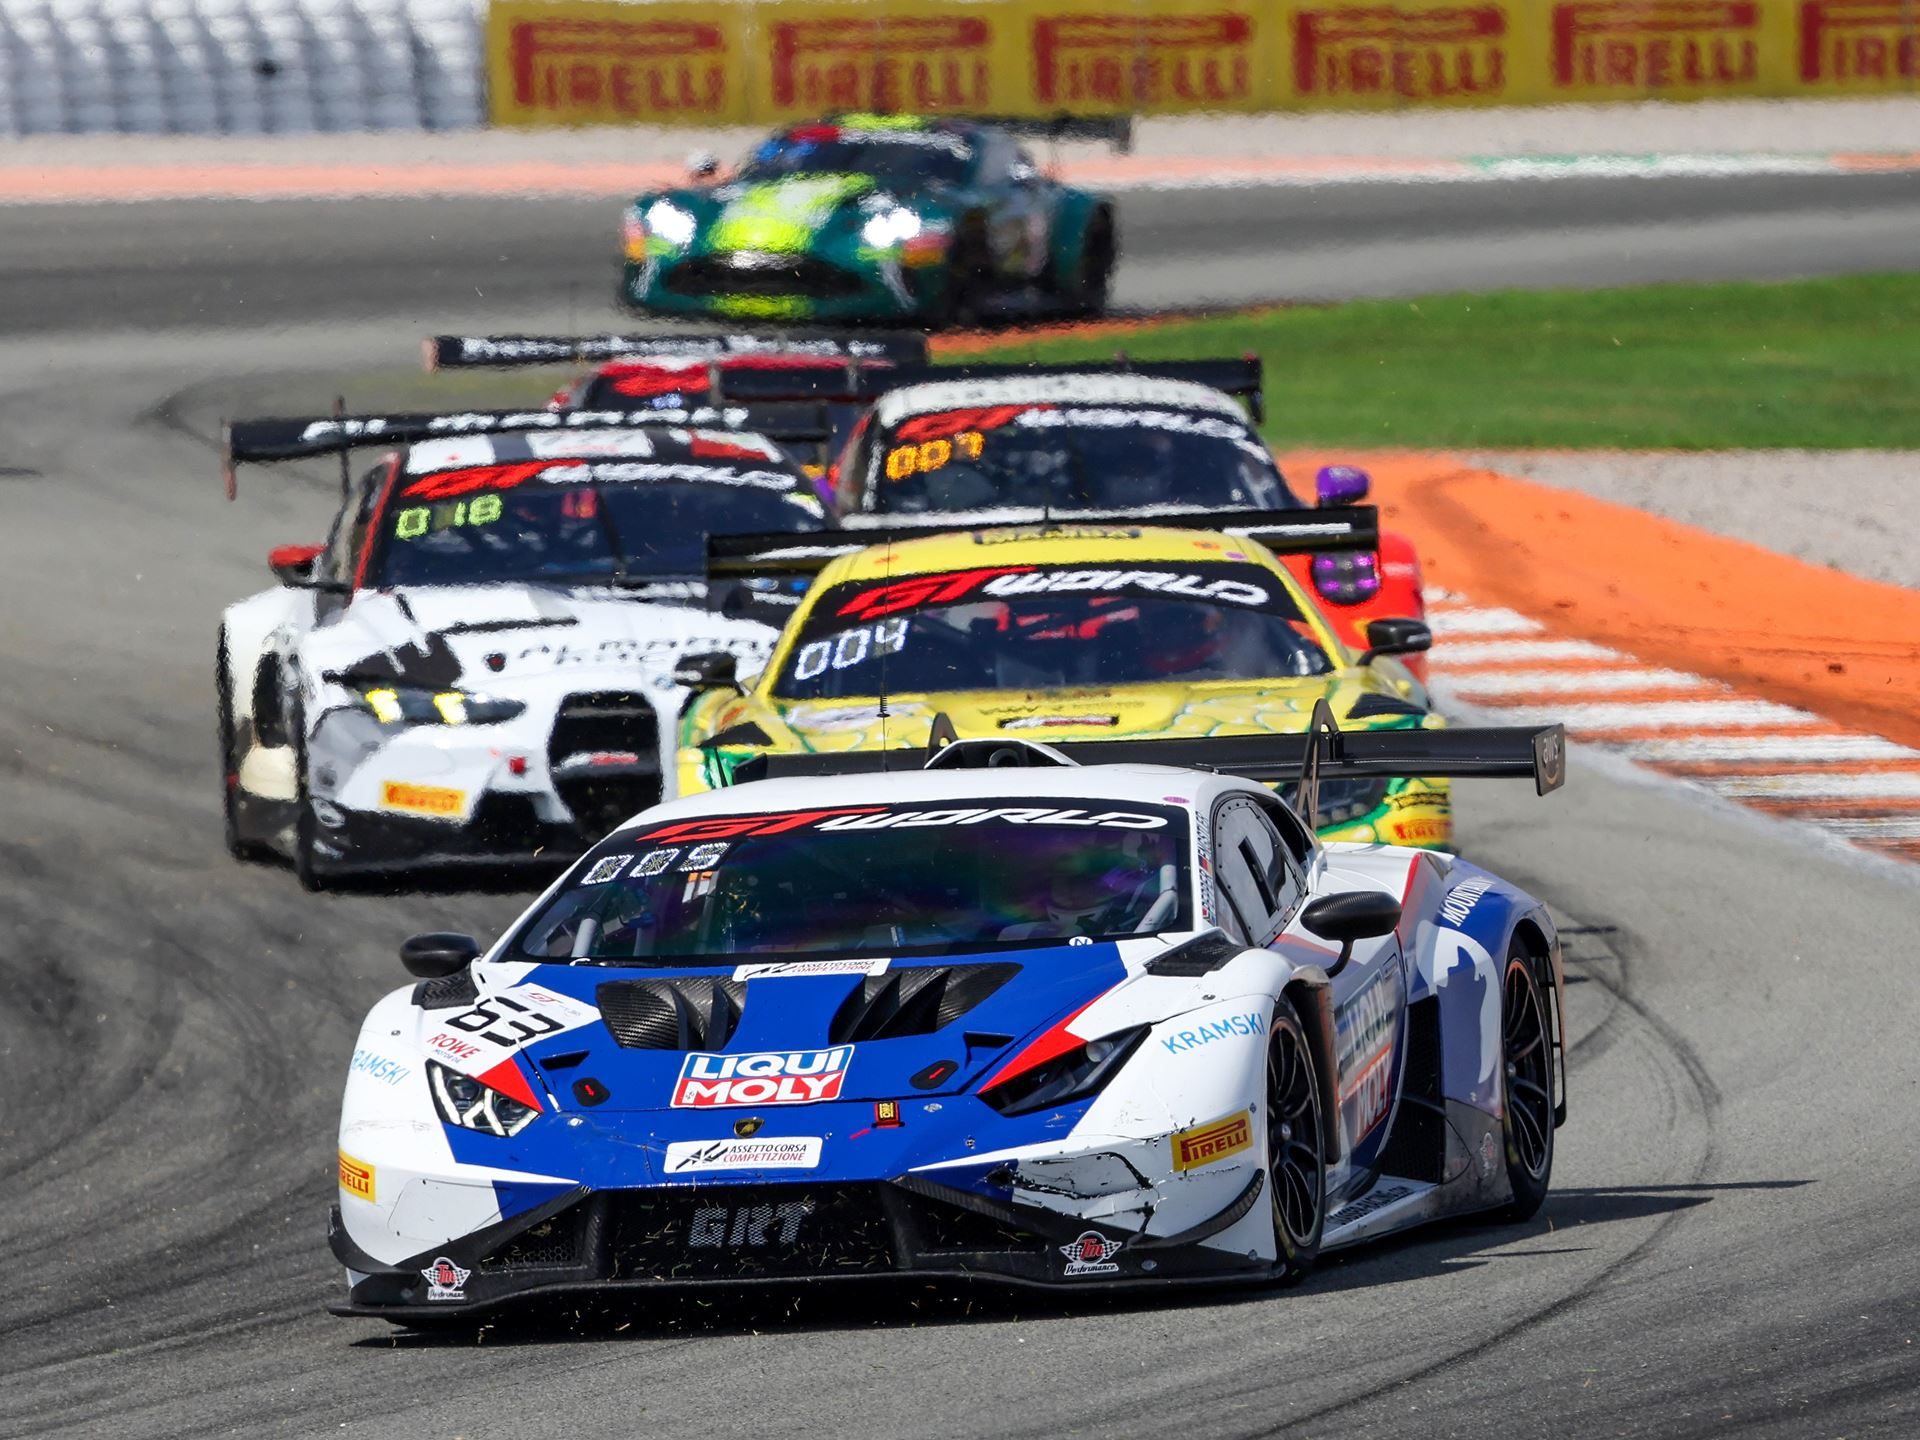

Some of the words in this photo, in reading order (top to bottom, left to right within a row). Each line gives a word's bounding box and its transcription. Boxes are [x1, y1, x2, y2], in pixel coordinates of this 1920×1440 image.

[511, 16, 726, 110] PIRELLI
[771, 16, 992, 108] PIRELLI
[1032, 13, 1254, 107] PIRELLI
[1292, 7, 1509, 96] PIRELLI
[1550, 0, 1762, 87] PIRELLI
[1797, 0, 1920, 84] PIRE
[836, 566, 1037, 620] GT
[982, 570, 1269, 605] WORLD
[794, 618, 908, 681] 004
[636, 808, 889, 842] GT
[814, 808, 1168, 831] WORLD
[445, 996, 565, 1047] 63
[1161, 1013, 1265, 1054] KRAMSKI
[427, 1034, 480, 1058] ROWE
[690, 1050, 838, 1079] LIQUI
[683, 1073, 841, 1104] MOLY
[723, 1152, 804, 1162] COMPETIZIONE
[729, 1144, 774, 1153] ASSETTO
[774, 1143, 807, 1152] CORSA
[1180, 1119, 1247, 1162] PIRELLI
[338, 1157, 369, 1194] RELLI
